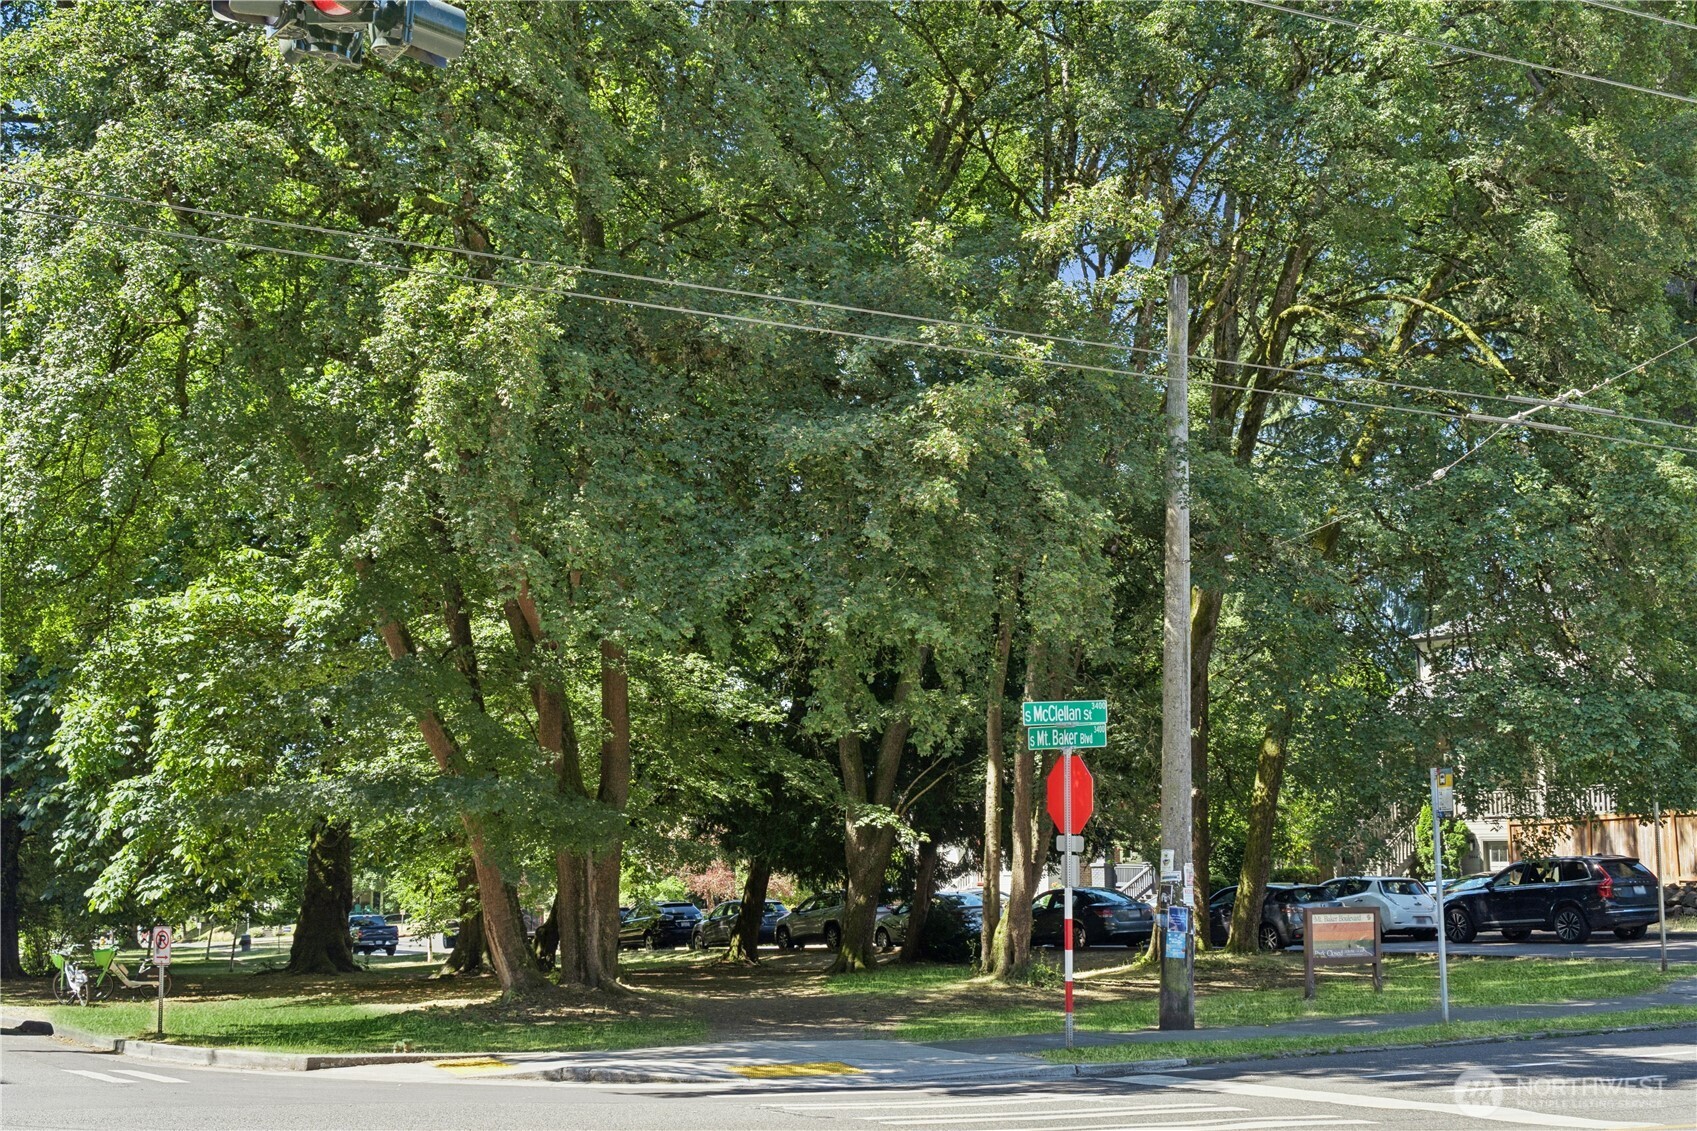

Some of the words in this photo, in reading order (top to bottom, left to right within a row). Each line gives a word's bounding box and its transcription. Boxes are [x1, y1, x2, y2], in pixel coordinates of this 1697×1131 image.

[1091, 702, 1106, 710] 3400
[1025, 711, 1032, 722] S
[1033, 705, 1081, 722] McClellan
[1083, 709, 1093, 720] St
[1093, 726, 1106, 734] 3400
[1030, 736, 1035, 747] S
[1037, 730, 1051, 746] Mt.
[1052, 729, 1078, 746] Baker
[1080, 733, 1093, 744] Blvd
[1338, 914, 1361, 922] Boulevard
[1326, 949, 1344, 957] Closed
